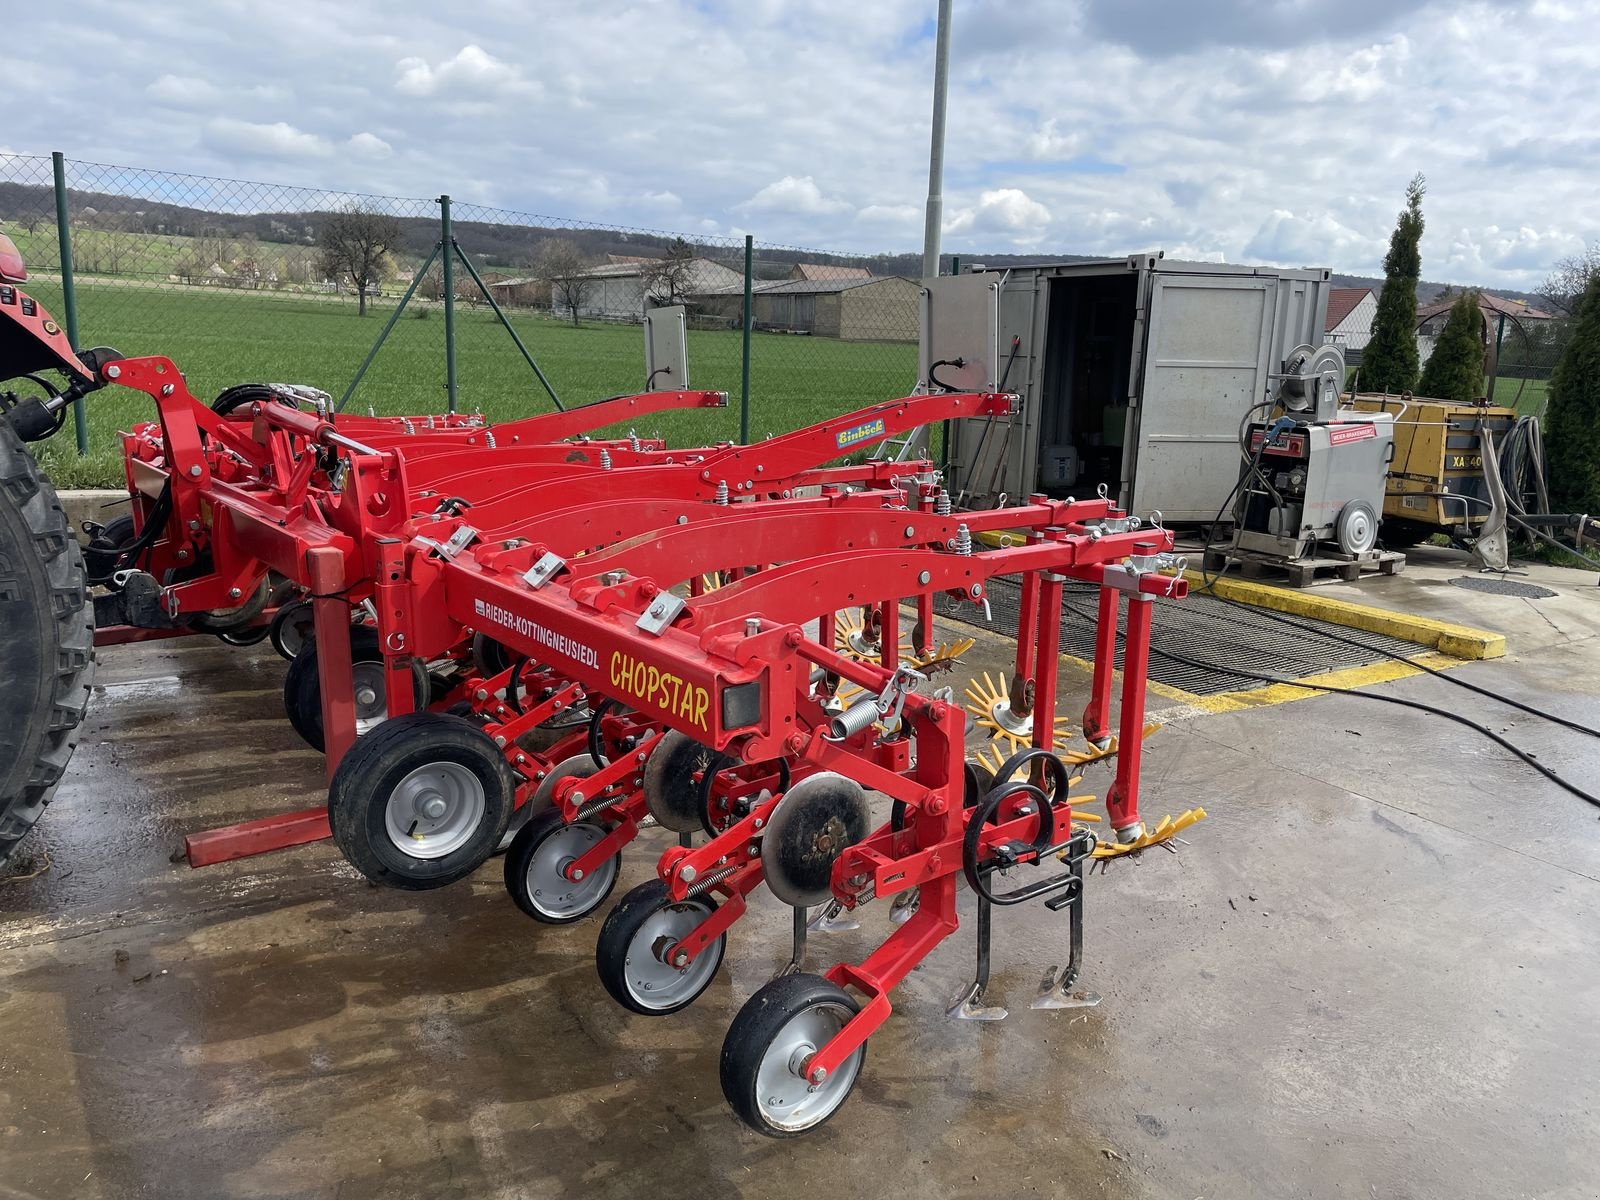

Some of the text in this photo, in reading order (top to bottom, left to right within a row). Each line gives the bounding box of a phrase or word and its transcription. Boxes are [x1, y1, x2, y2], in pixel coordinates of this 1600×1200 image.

[838, 420, 883, 444] Einböck
[485, 602, 599, 670] RIEDER-KOTTINGNEUSIEDL
[610, 651, 709, 732] CHOPSTAR
